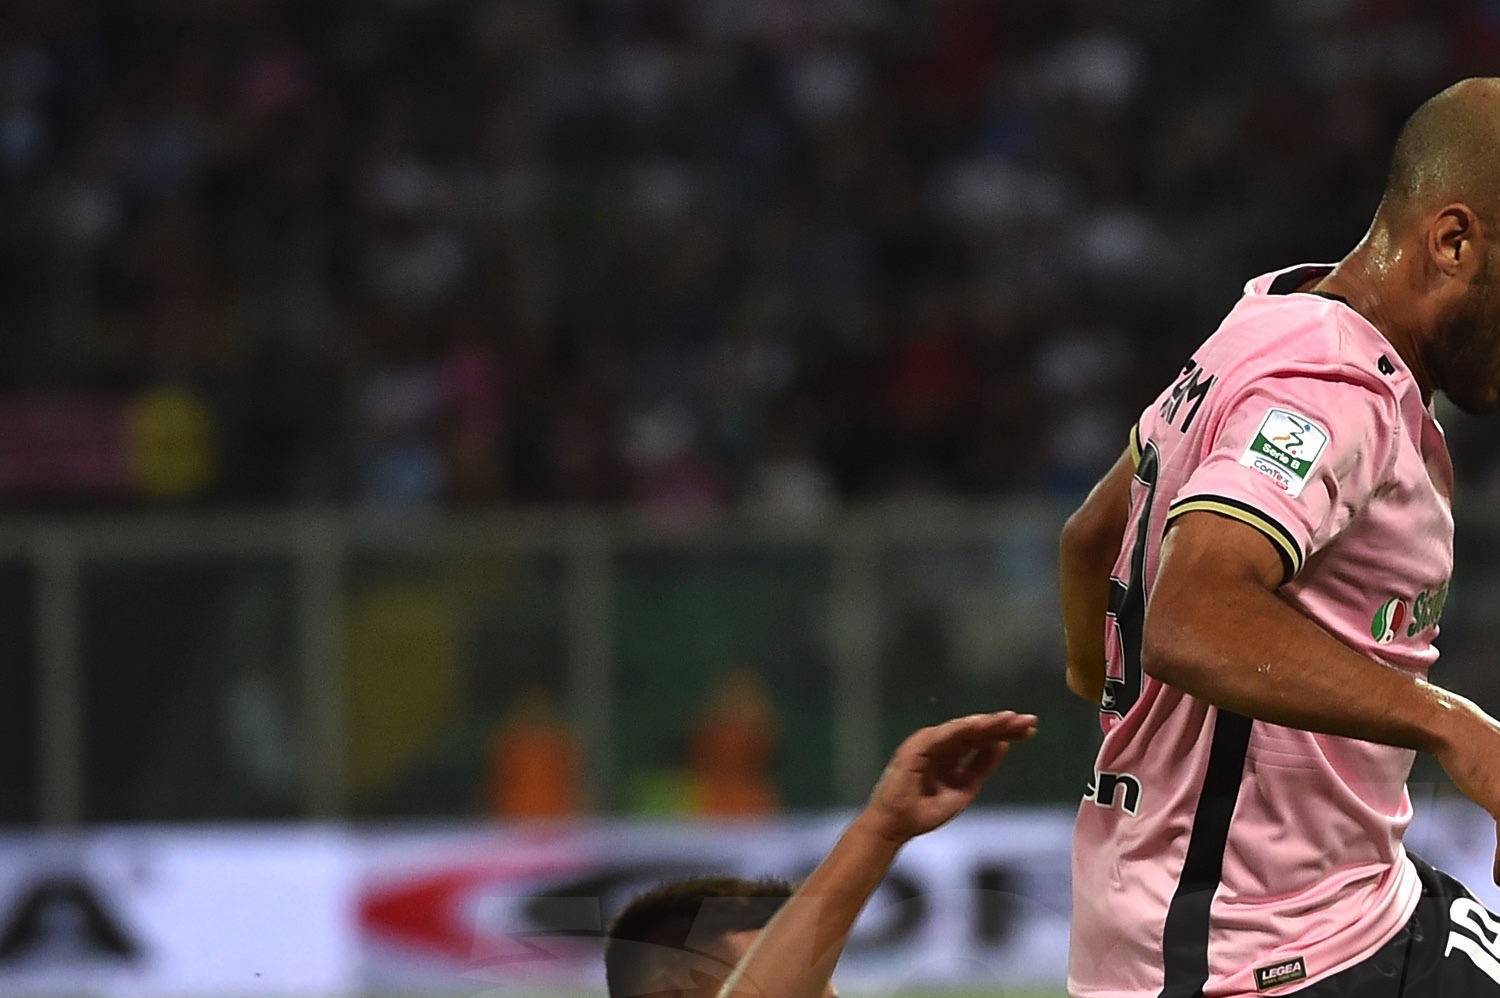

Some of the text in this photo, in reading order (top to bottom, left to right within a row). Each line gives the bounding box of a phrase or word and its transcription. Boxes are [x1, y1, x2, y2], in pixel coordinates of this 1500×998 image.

[1262, 443, 1301, 470] Serie B
[1262, 961, 1302, 981] LEGEA
